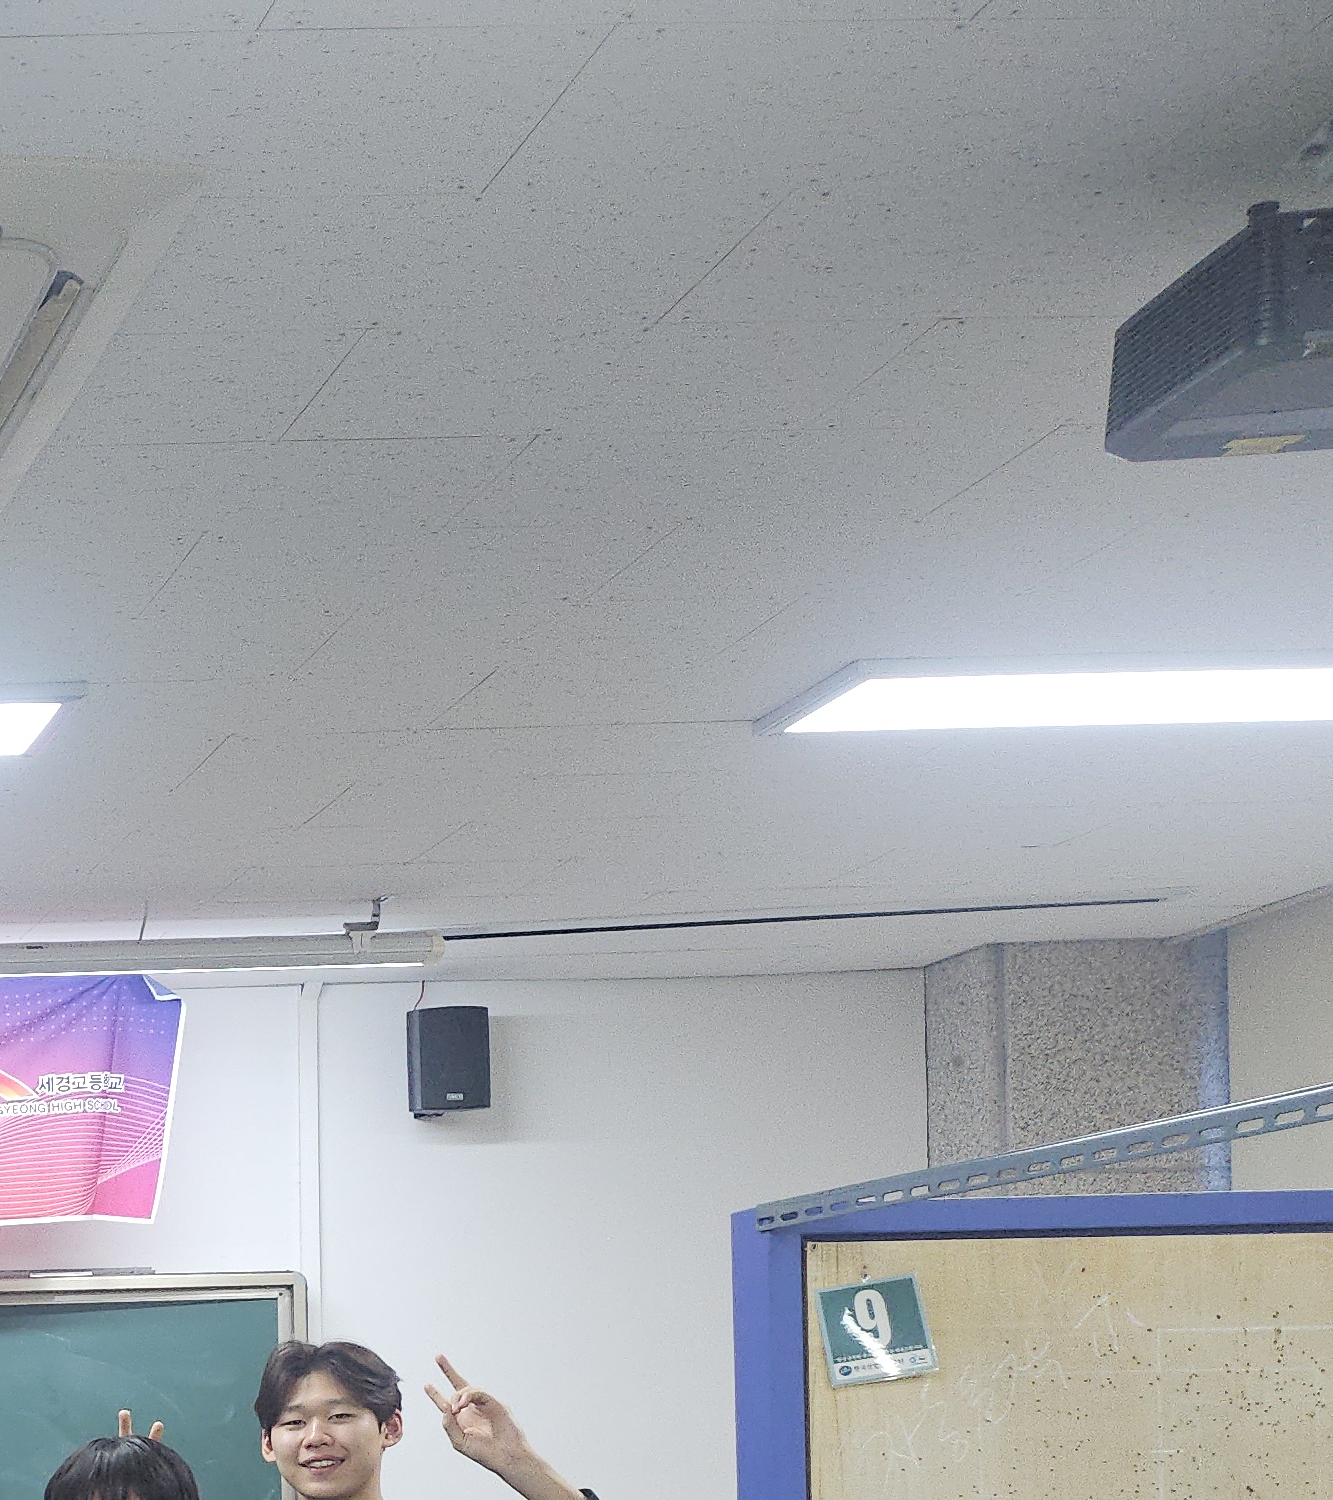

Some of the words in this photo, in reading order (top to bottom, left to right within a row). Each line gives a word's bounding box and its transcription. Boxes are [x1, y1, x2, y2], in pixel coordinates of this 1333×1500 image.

[51, 1101, 82, 1113] HIGH
[87, 1100, 119, 1112] SCOL
[854, 1289, 891, 1349] 9
